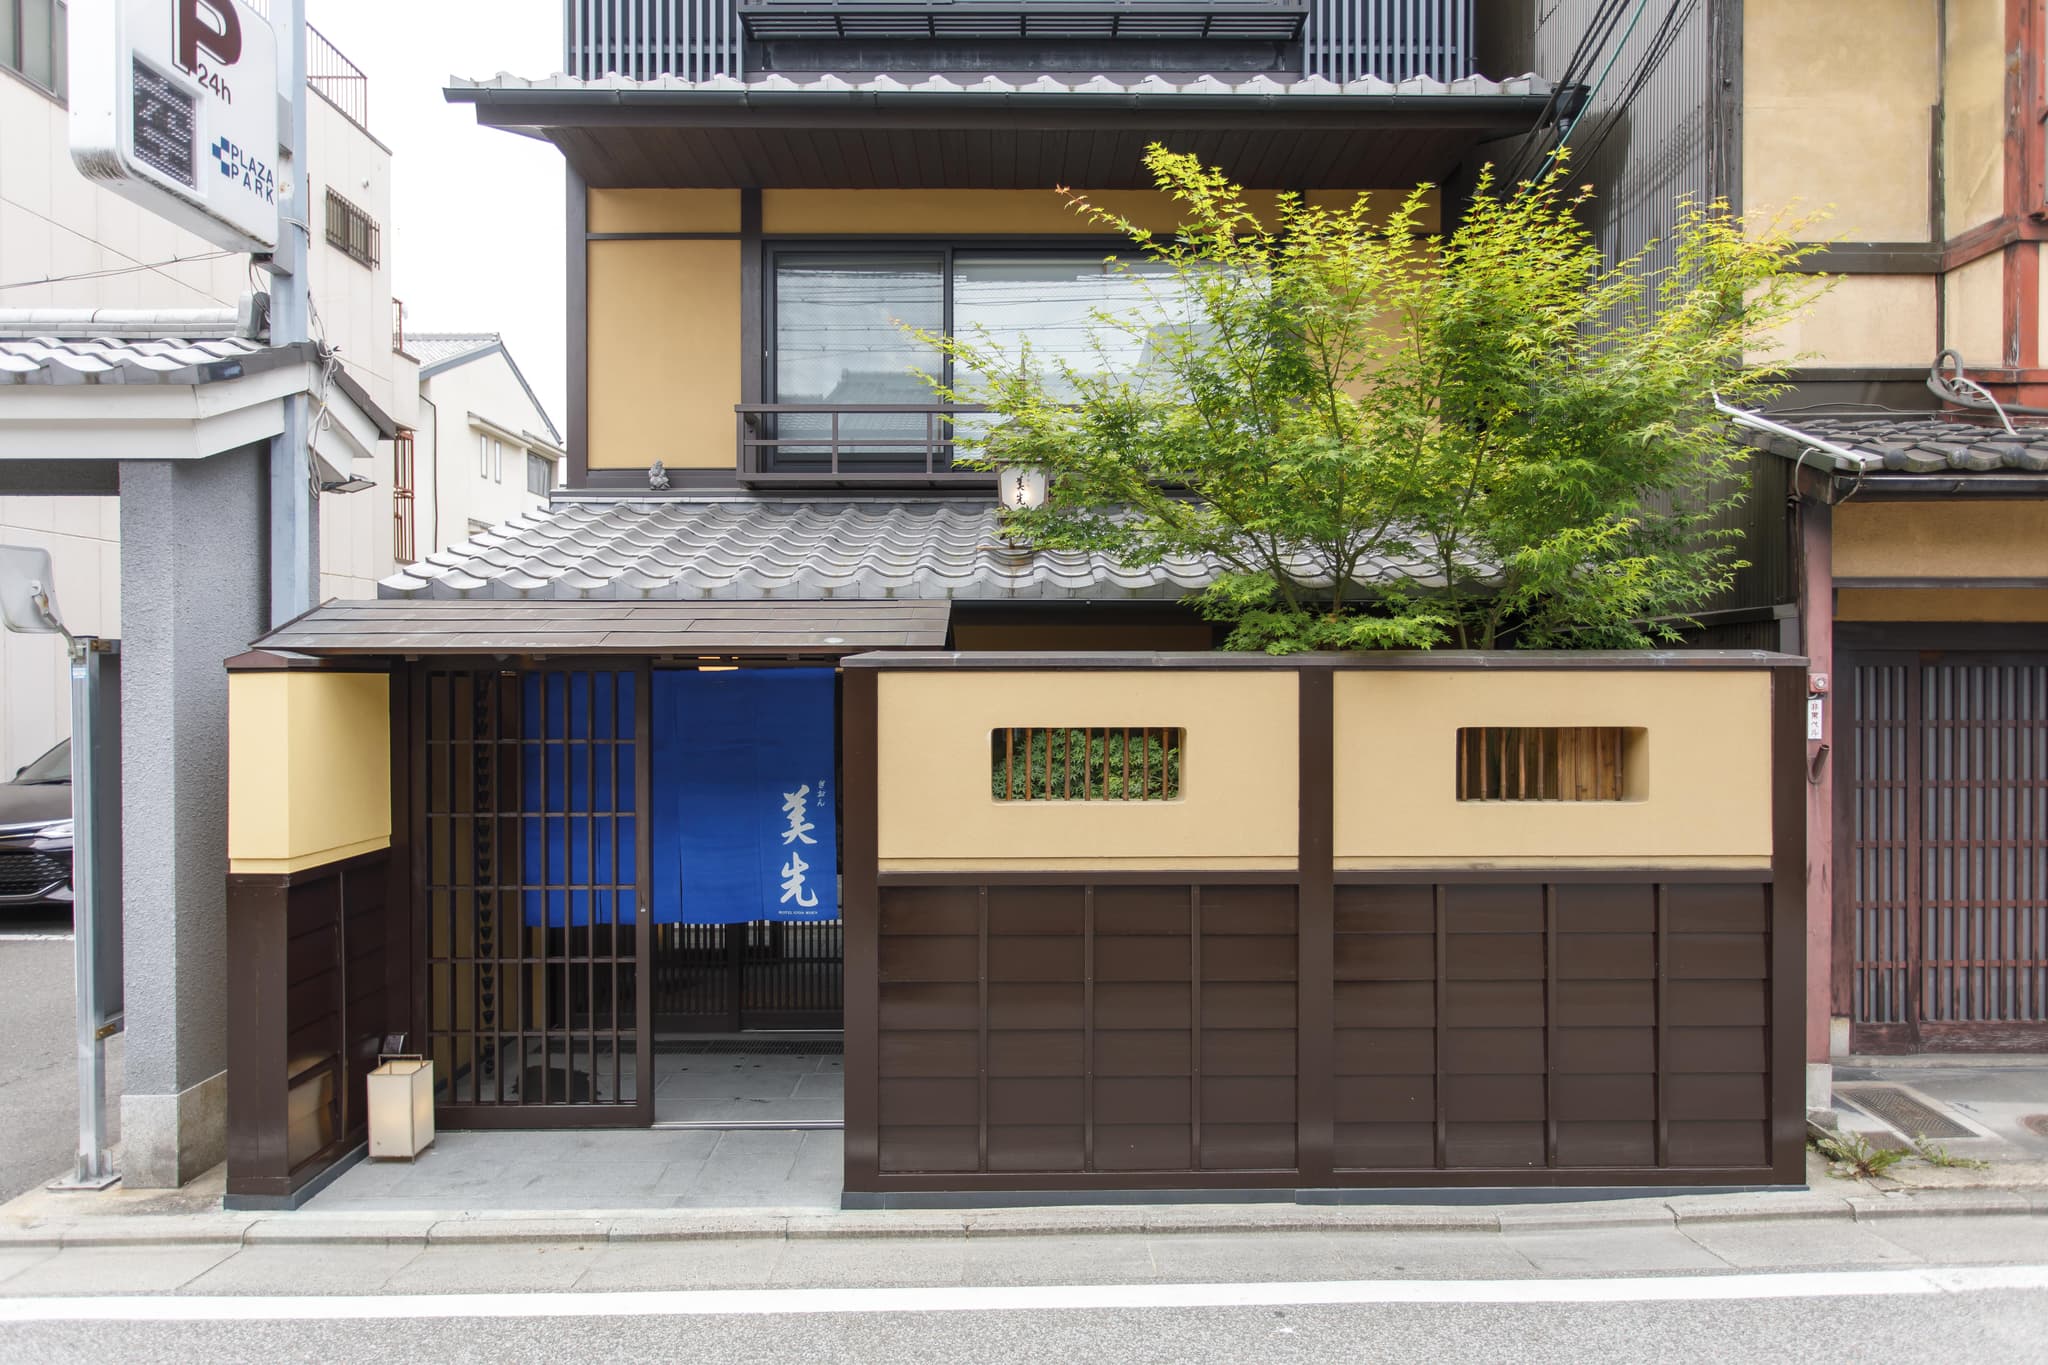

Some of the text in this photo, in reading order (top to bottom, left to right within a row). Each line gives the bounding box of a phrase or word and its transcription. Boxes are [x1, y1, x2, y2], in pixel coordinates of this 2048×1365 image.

[172, 0, 242, 76] P
[198, 63, 231, 104] 24h
[134, 74, 196, 189] 空
[231, 144, 274, 187] PLAZA
[231, 163, 274, 205] PARK
[817, 780, 826, 807] ぎおん
